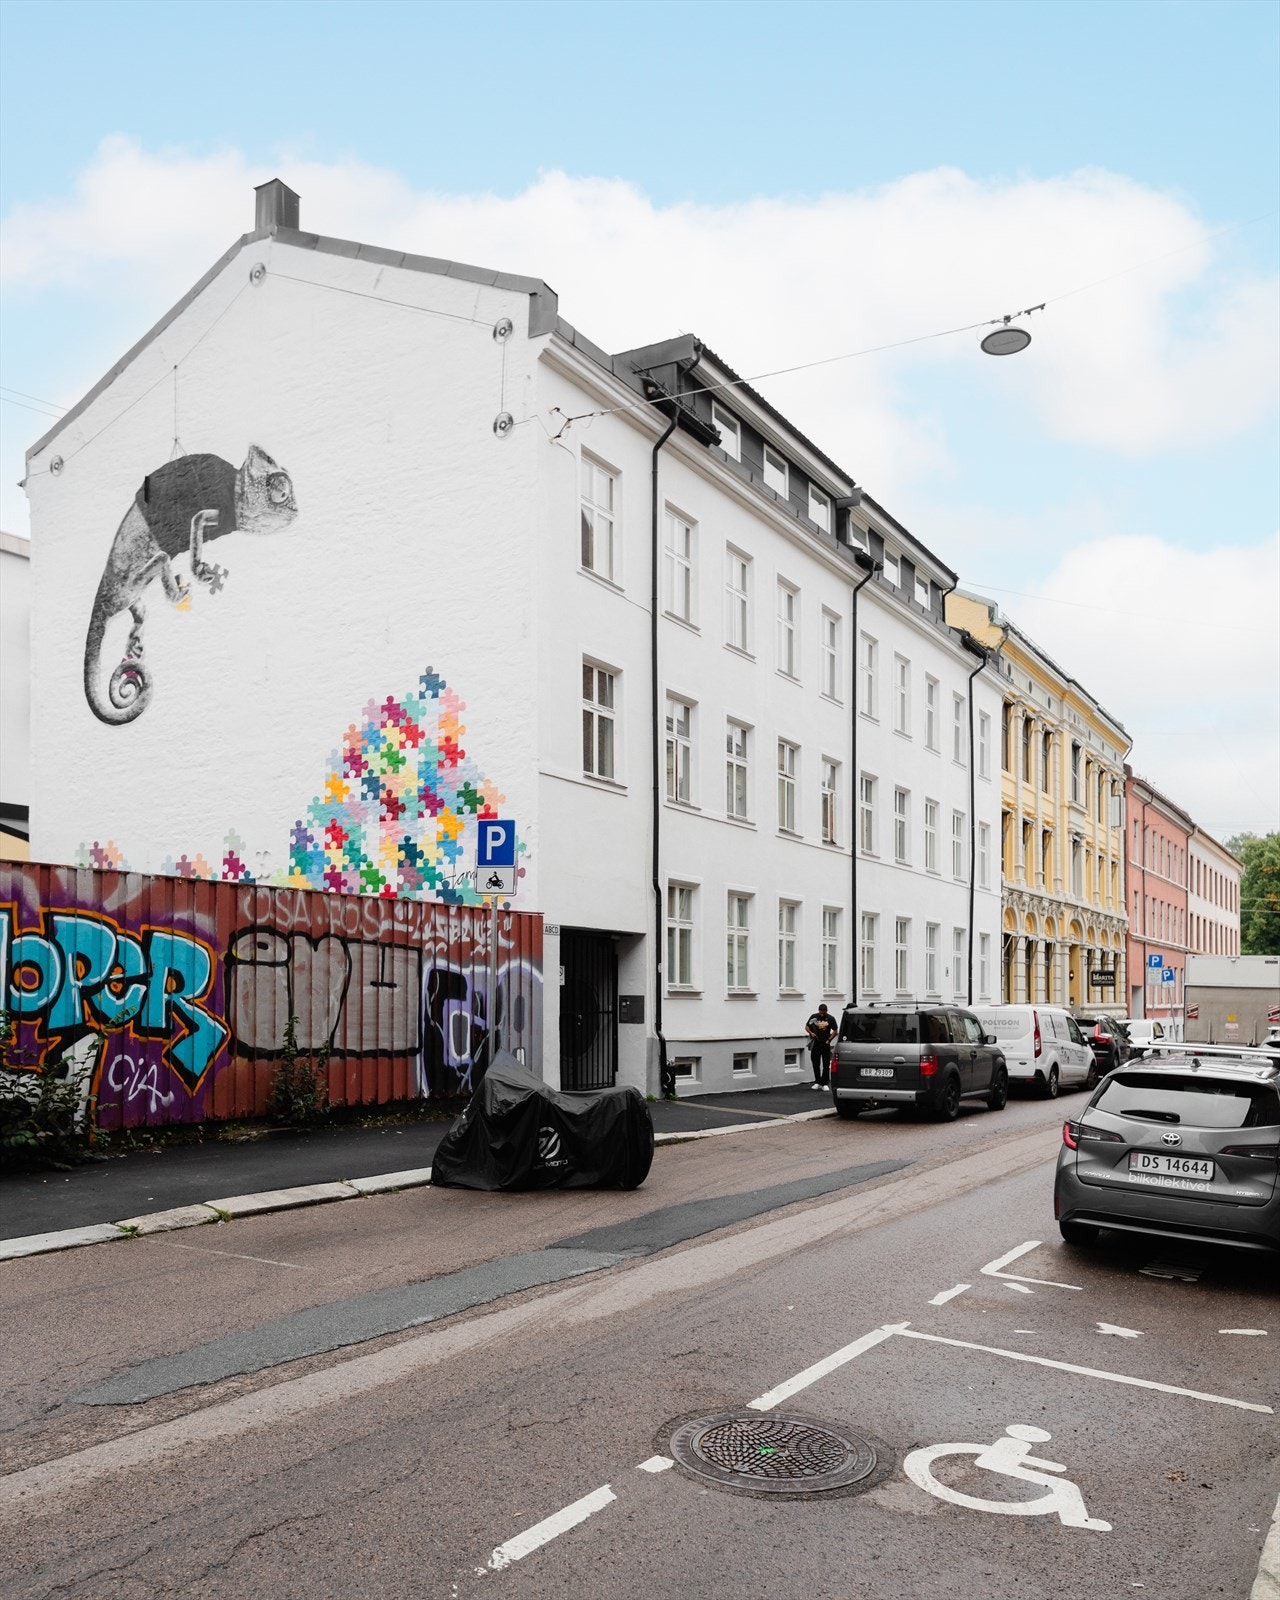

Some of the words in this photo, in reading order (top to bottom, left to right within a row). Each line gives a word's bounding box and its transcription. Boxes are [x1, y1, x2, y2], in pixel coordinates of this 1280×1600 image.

[486, 825, 506, 860] P
[545, 926, 559, 934] ABCD
[1151, 956, 1160, 967] P
[1163, 971, 1171, 981] P
[1142, 1155, 1159, 1169] DS
[1165, 1158, 1209, 1175] 14644
[1128, 1172, 1212, 1192] bilkollektivet
